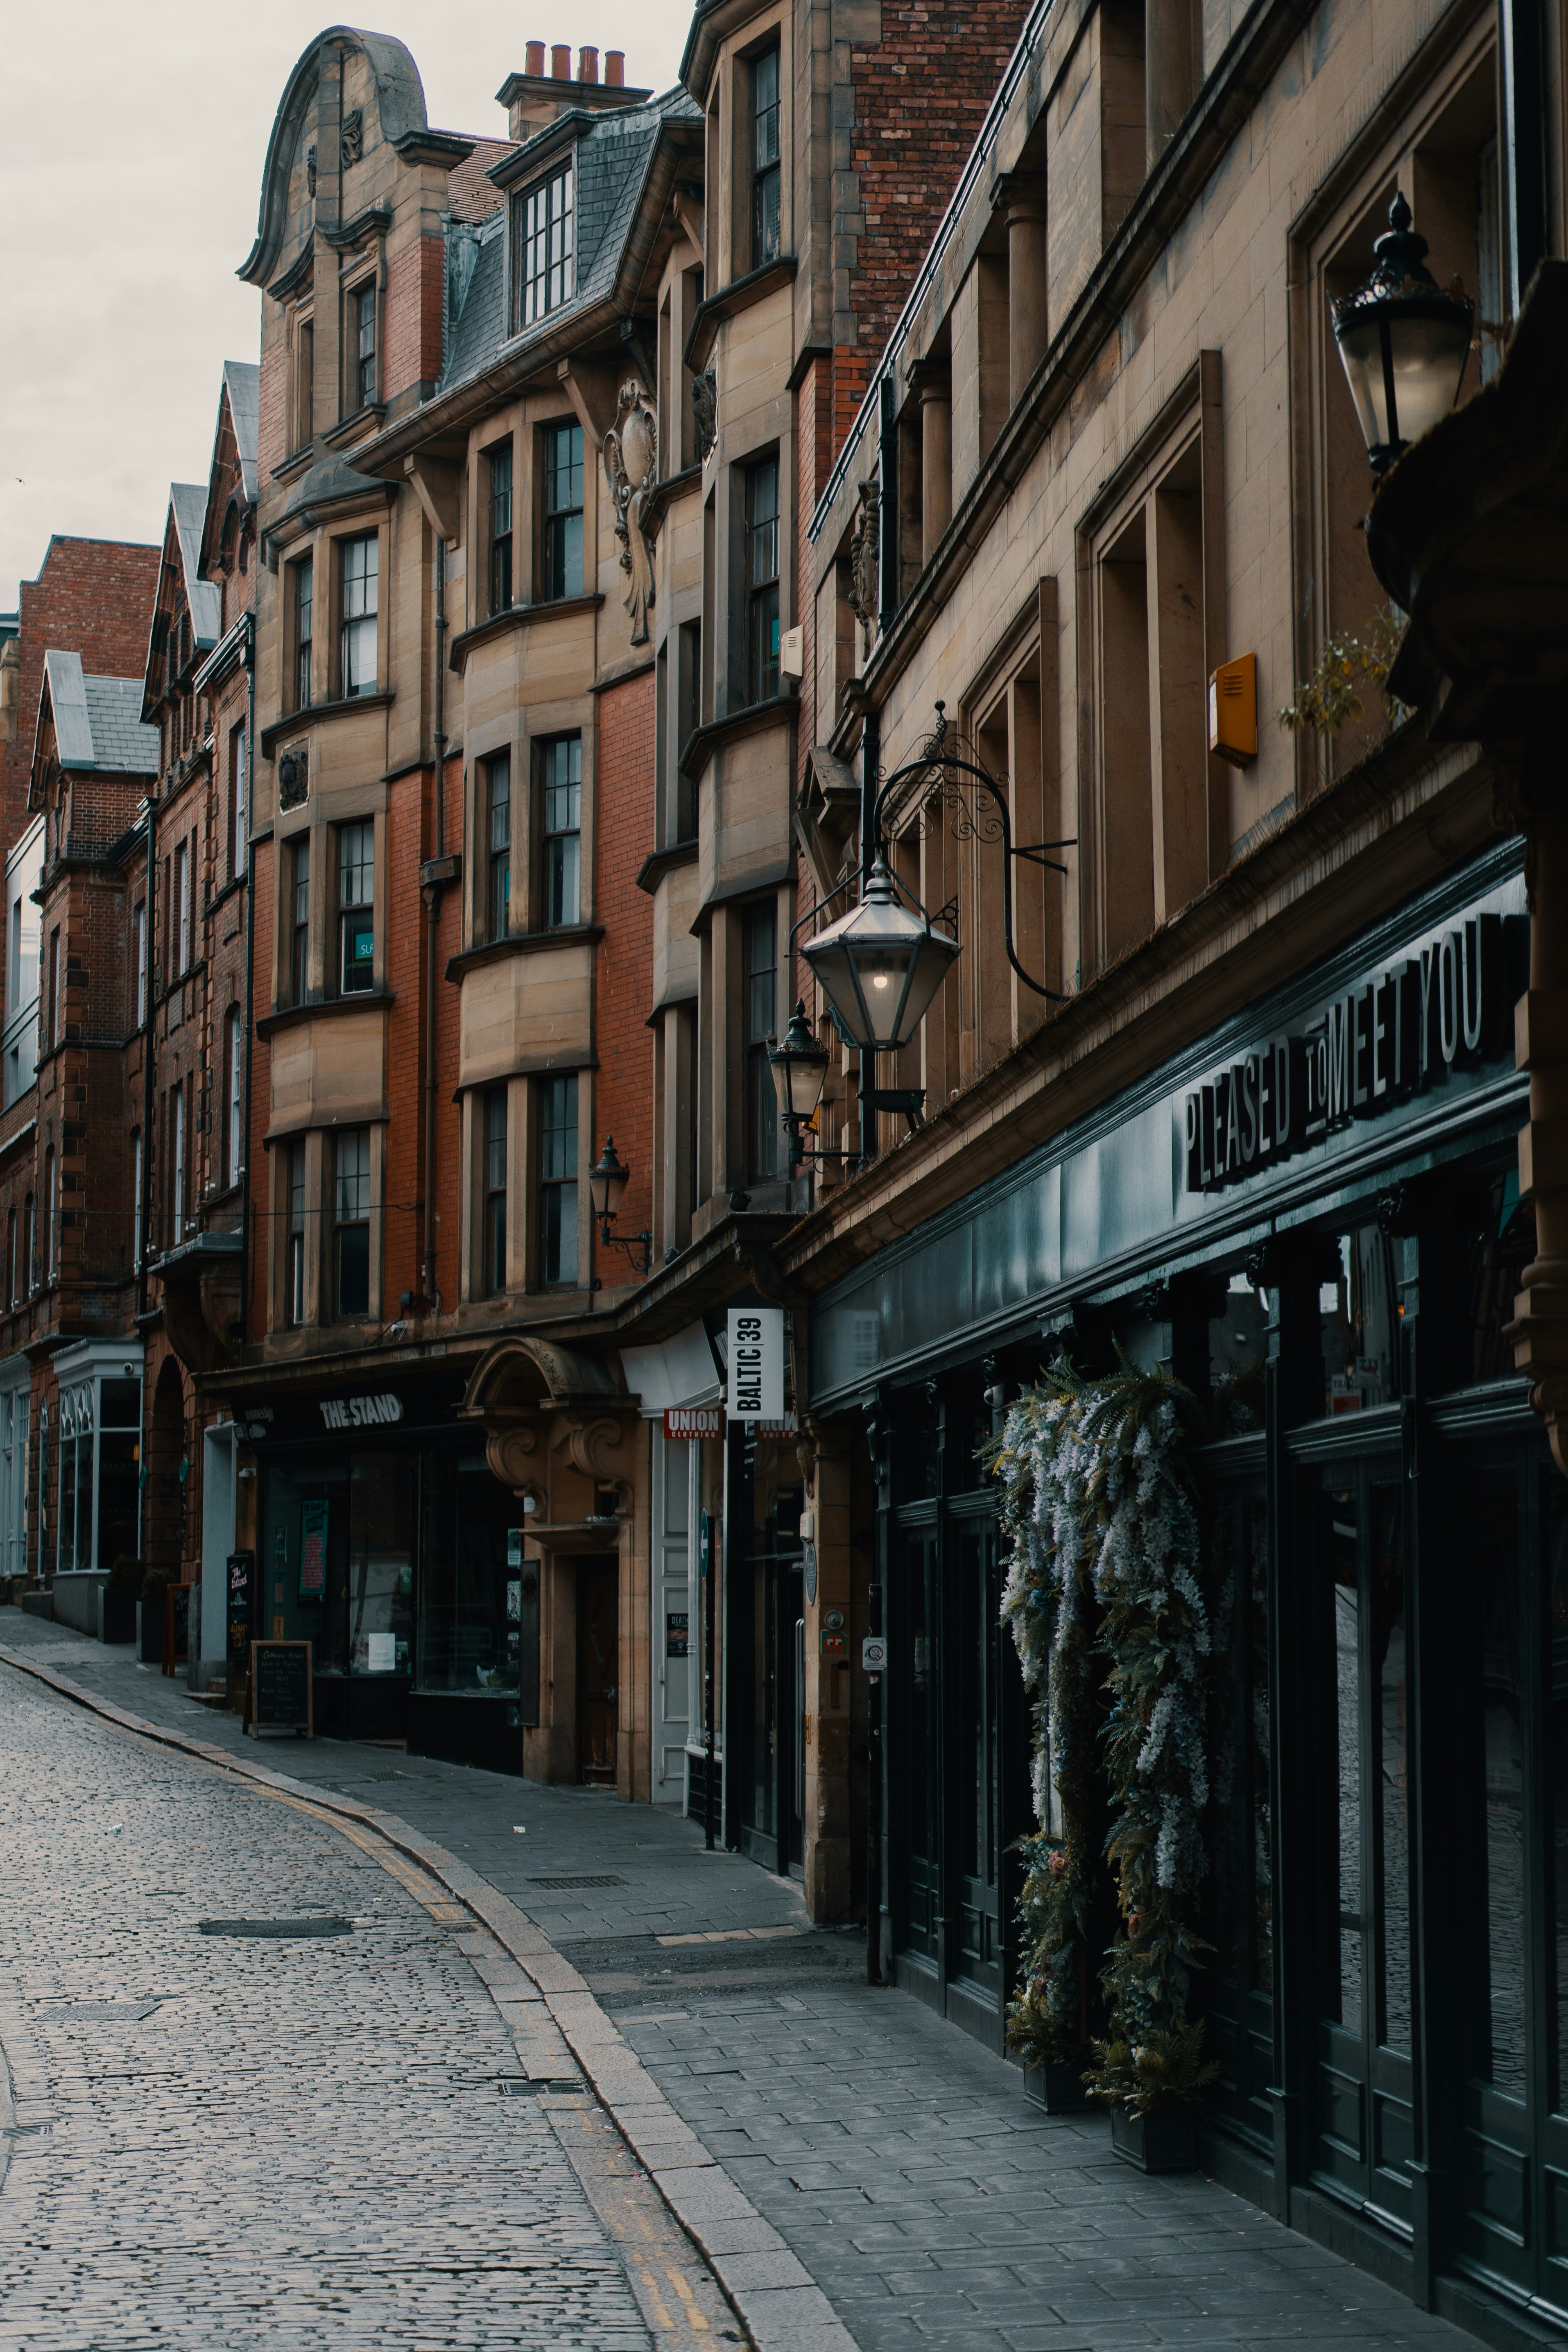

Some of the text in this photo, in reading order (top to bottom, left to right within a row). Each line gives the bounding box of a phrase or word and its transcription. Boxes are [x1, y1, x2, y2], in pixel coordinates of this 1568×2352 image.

[1185, 913, 1483, 1192] PLEASED TO MEET YOU
[737, 1317, 761, 1341] 39
[737, 1349, 761, 1411] BALTIC
[245, 1404, 271, 1422] comedy
[319, 1393, 402, 1429] THE STAND
[668, 1410, 719, 1431] UNION
[249, 1423, 263, 1439] club
[672, 1616, 688, 1624] DEATH
